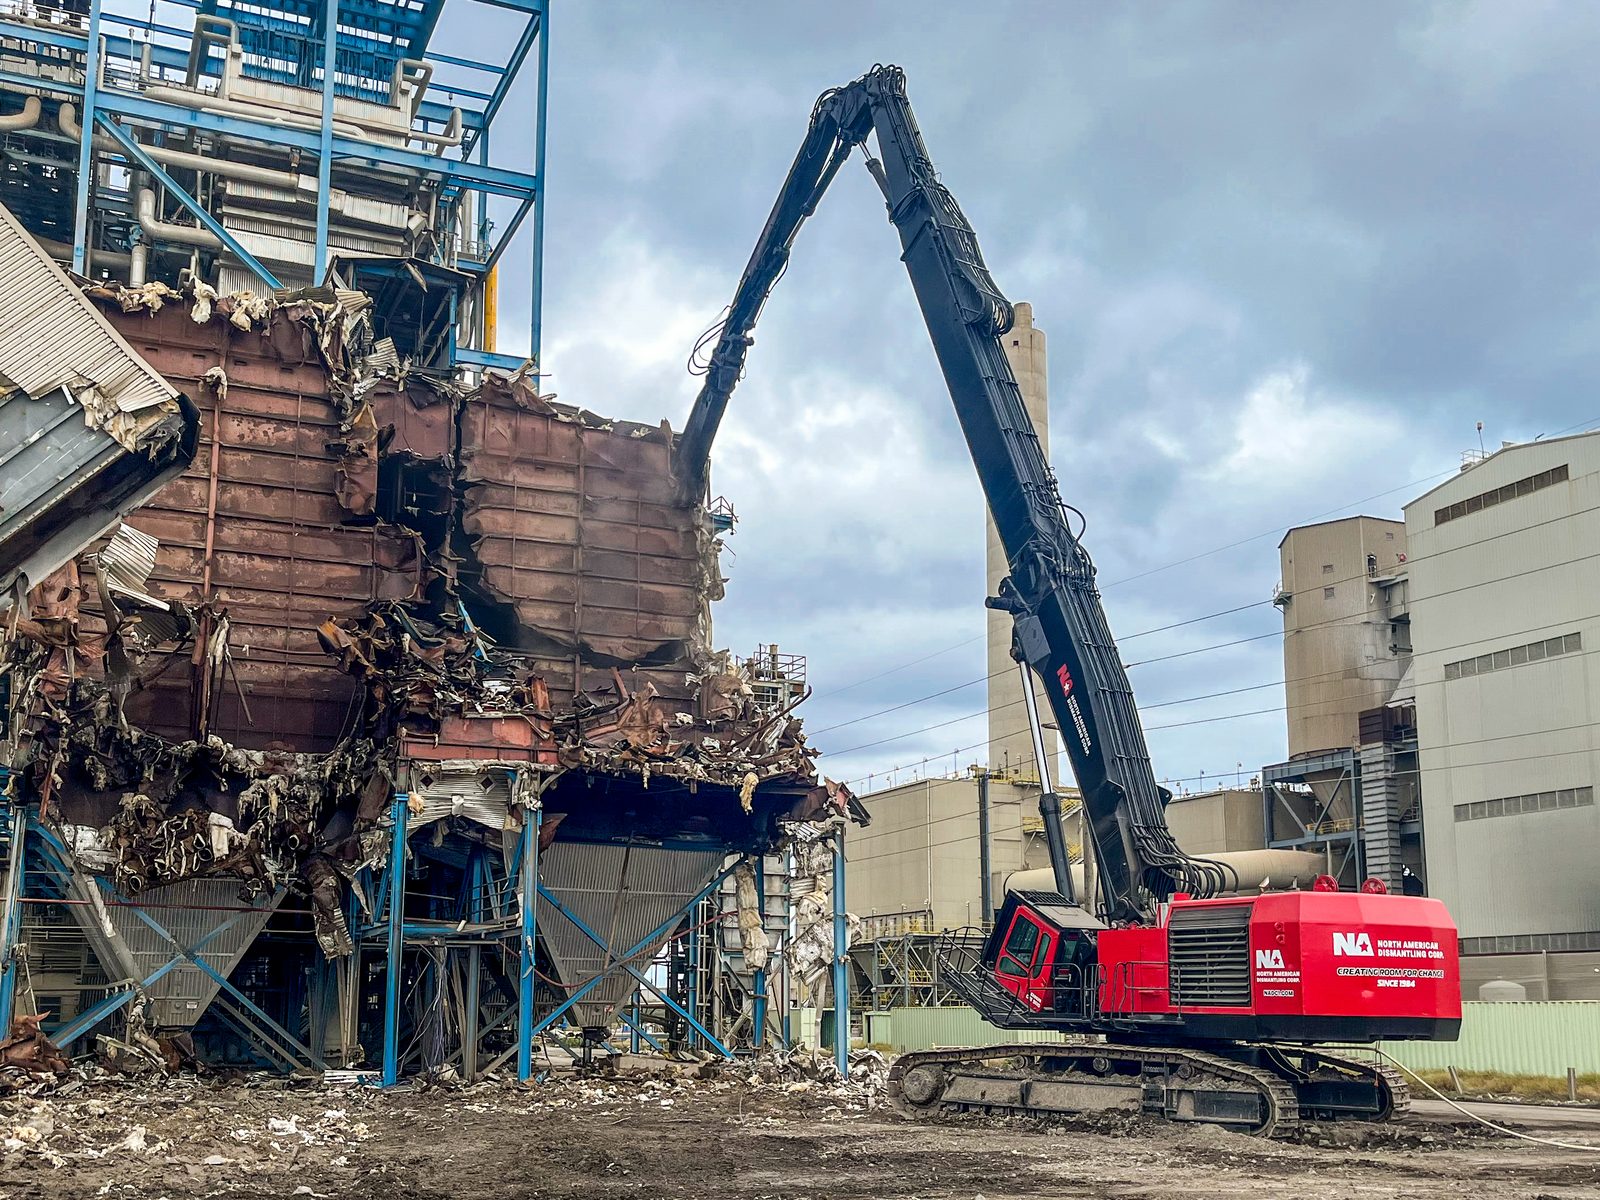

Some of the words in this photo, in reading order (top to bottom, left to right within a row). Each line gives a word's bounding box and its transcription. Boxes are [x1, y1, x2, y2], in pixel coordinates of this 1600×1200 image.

[1067, 698, 1083, 739] DISMANTLING
[1080, 738, 1090, 757] CORP.
[1070, 694, 1080, 715] NORTH
[1077, 715, 1092, 747] AMERICAN
[1332, 932, 1375, 957] NA
[1377, 940, 1401, 949] NORTH
[1403, 940, 1439, 950] AMERICAN
[1256, 949, 1286, 969] NA
[1378, 949, 1427, 958] DISMANTLING
[1428, 951, 1445, 959] CORP.
[1336, 967, 1379, 976] CREATING
[1379, 968, 1402, 977] ROOM
[1402, 969, 1418, 977] FOR
[1418, 969, 1444, 978] CHANGE
[1377, 979, 1399, 988] SINCE
[1399, 979, 1416, 988] 1984
